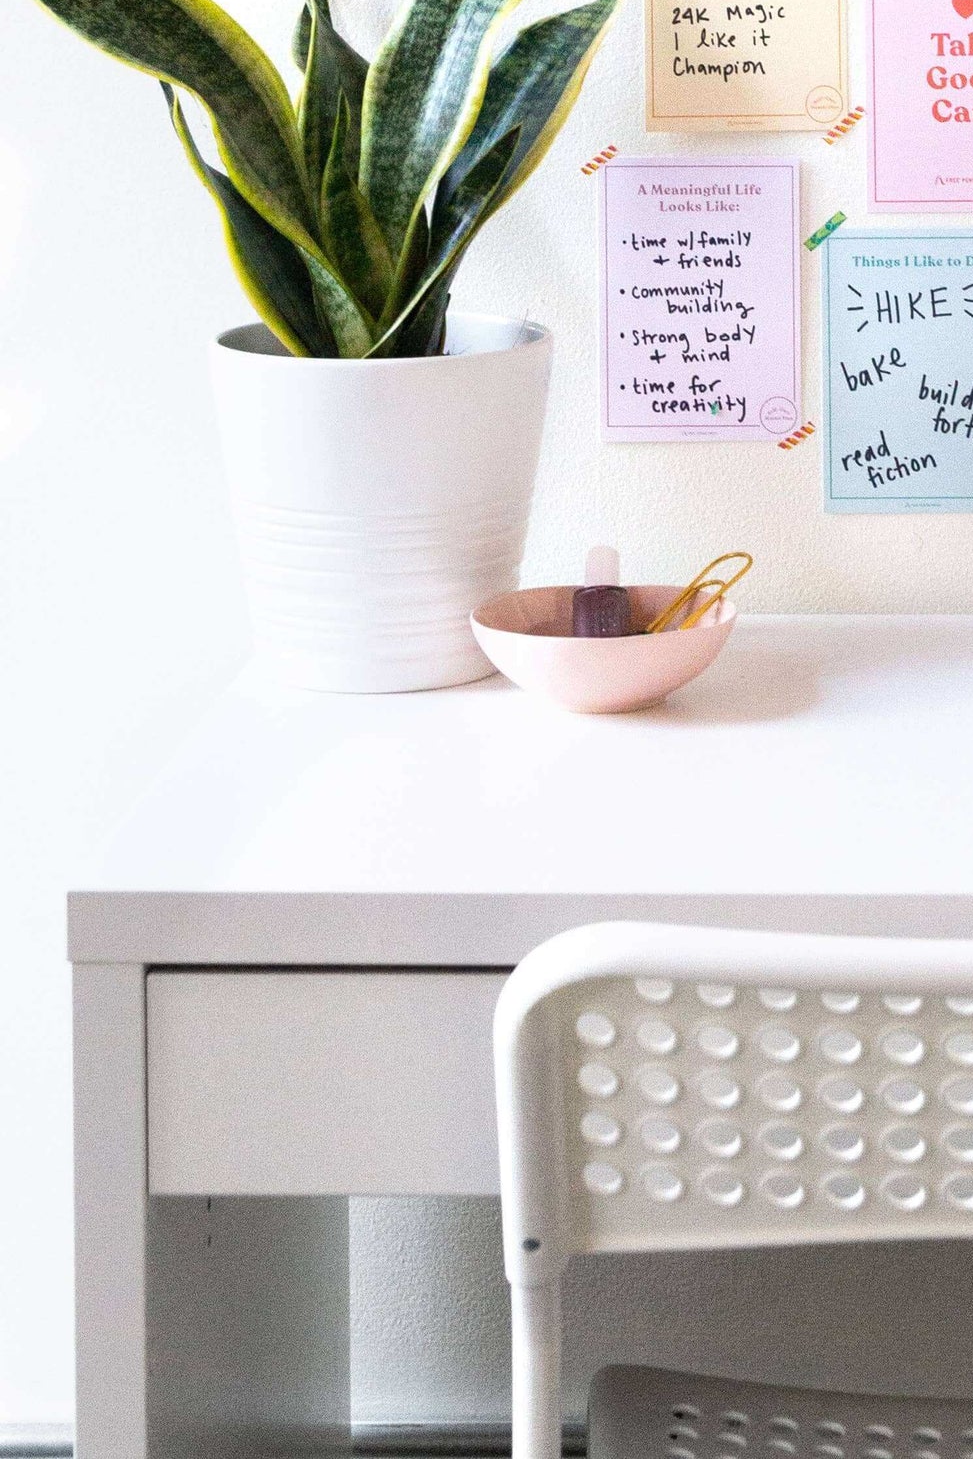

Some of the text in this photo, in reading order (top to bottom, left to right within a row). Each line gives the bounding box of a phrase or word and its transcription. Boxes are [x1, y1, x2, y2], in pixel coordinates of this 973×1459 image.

[672, 4, 785, 25] 24K Magic
[697, 28, 736, 48] like
[753, 28, 770, 46] it
[673, 57, 765, 82] Champion
[637, 184, 762, 199] A Meaningful Life
[659, 201, 740, 212] Looks Like:
[632, 233, 667, 251] time
[678, 250, 741, 269] friends
[852, 255, 901, 268] Things
[904, 255, 910, 267] I
[913, 255, 943, 267] Like
[946, 256, 962, 267] to
[632, 279, 723, 301] community
[666, 297, 754, 319] building
[876, 287, 952, 323] HIKE
[705, 324, 755, 344] body
[682, 342, 730, 363] mind
[840, 347, 906, 391] bake
[633, 375, 721, 395] time for
[652, 396, 746, 423] creativity
[841, 430, 894, 473] read
[865, 451, 937, 488] fiction
